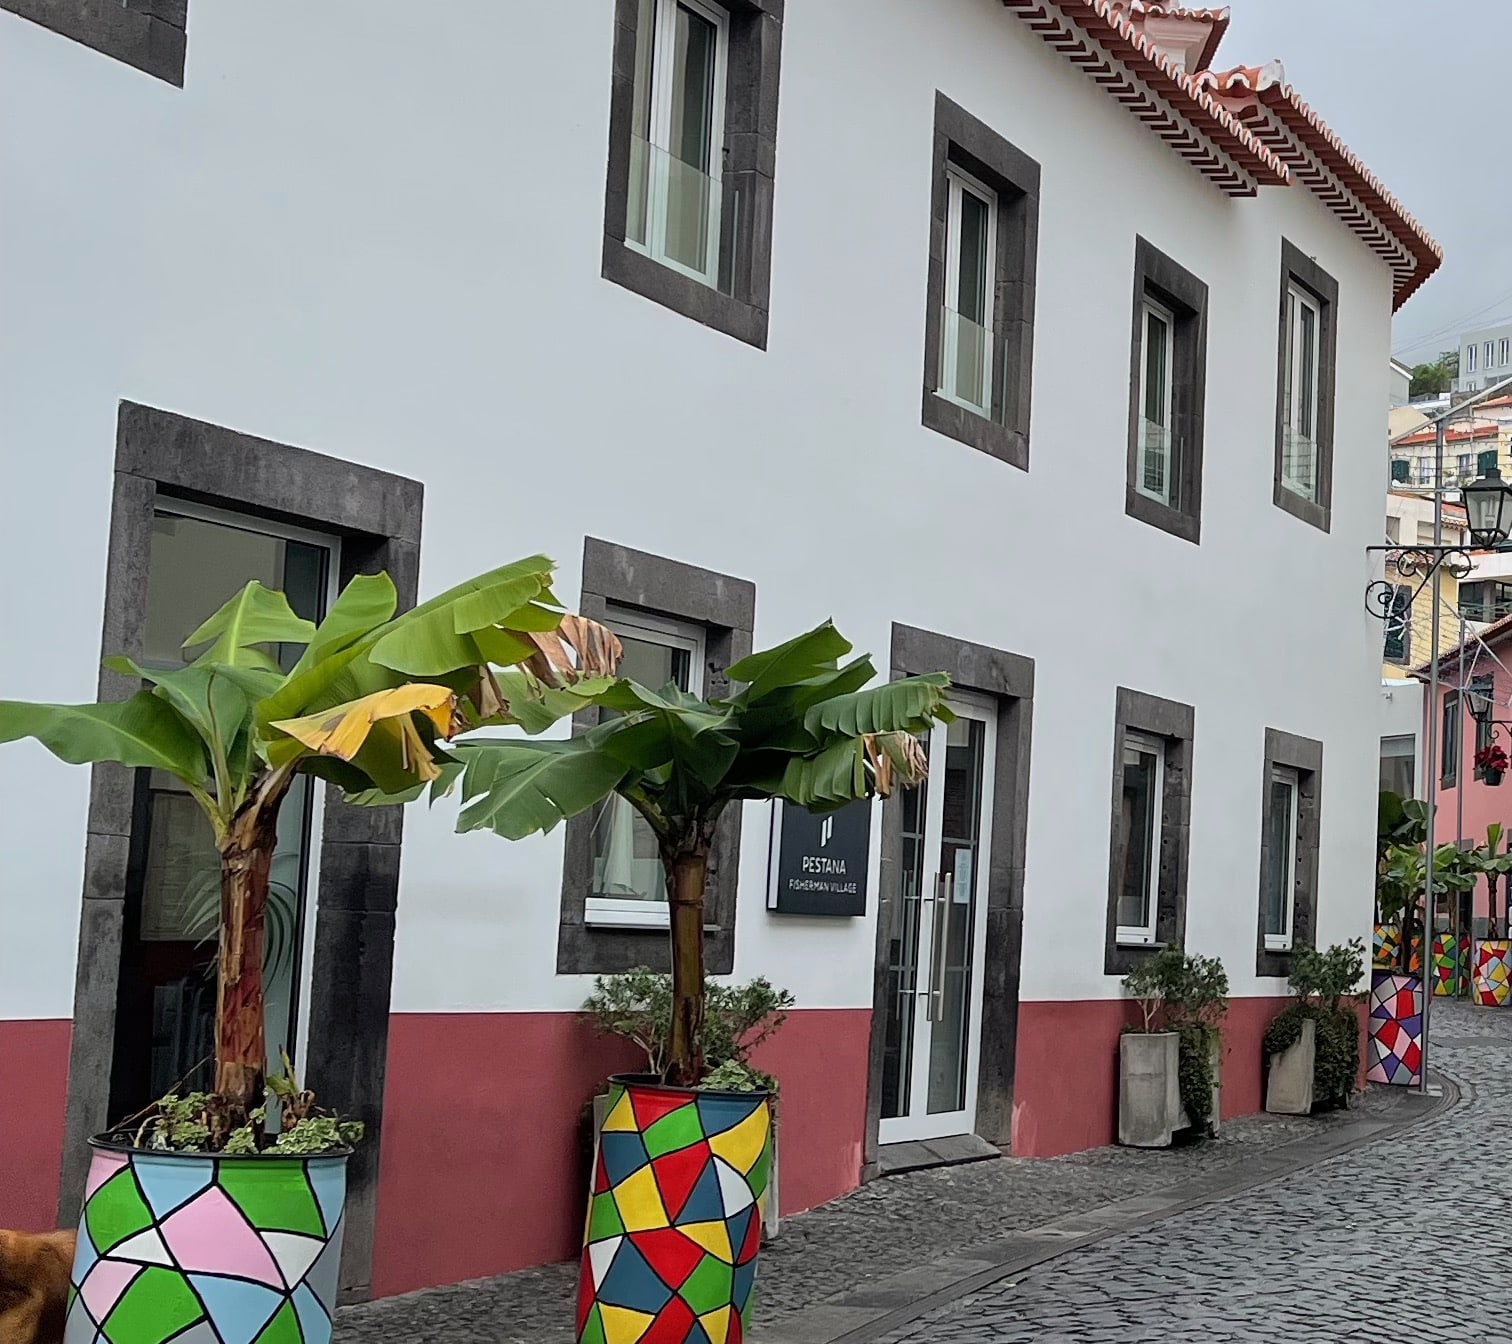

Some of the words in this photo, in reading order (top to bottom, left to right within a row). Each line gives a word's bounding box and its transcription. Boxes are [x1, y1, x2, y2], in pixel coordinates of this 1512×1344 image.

[802, 855, 847, 875] PESTANA
[788, 878, 829, 892] FISHERMAN
[830, 881, 857, 894] VILLAGE
